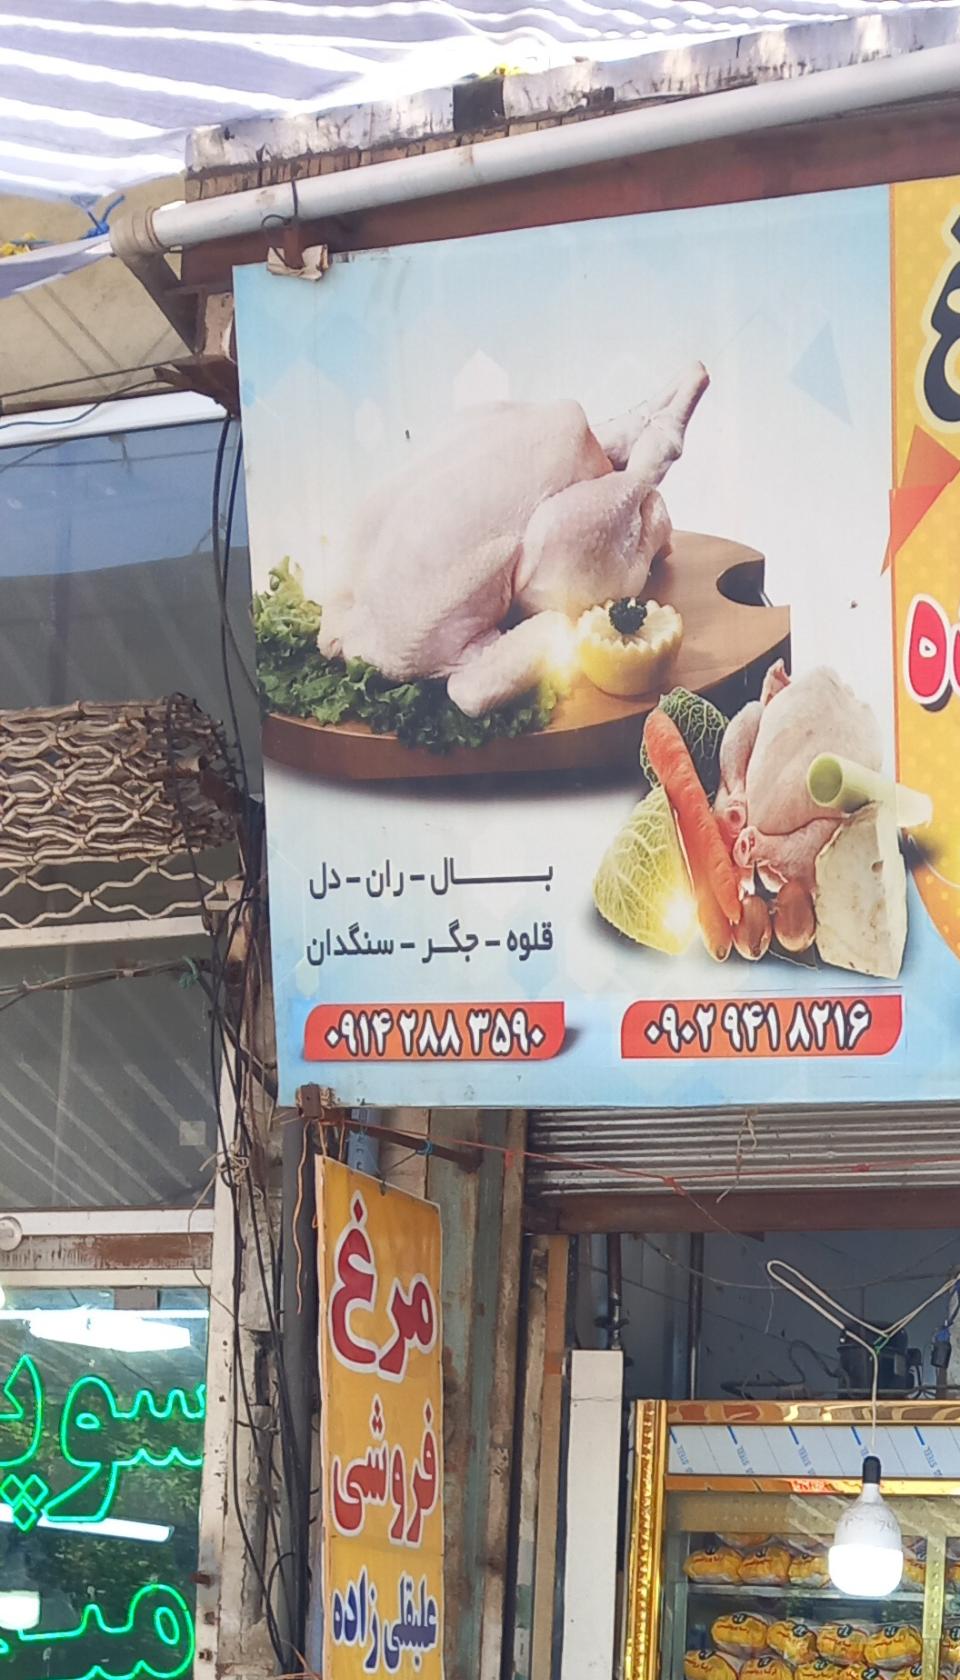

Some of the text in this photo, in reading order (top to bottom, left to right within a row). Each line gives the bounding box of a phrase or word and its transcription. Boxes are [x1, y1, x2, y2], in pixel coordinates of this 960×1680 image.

[309, 857, 553, 900] بال ران دل
[306, 919, 554, 967] قلوه جگر سنگدان
[325, 1006, 546, 1057] ۰۹۱۴ ۲۸۸ ۳۵۹۰
[645, 999, 872, 1053] ۰۹۰۲ ۹۴۱ ۸۲۱۶
[332, 1198, 434, 1375] مرغ
[0, 1355, 207, 1530] سوپ
[333, 1400, 437, 1543] فروشی
[333, 1569, 437, 1670] علیقلی زاده
